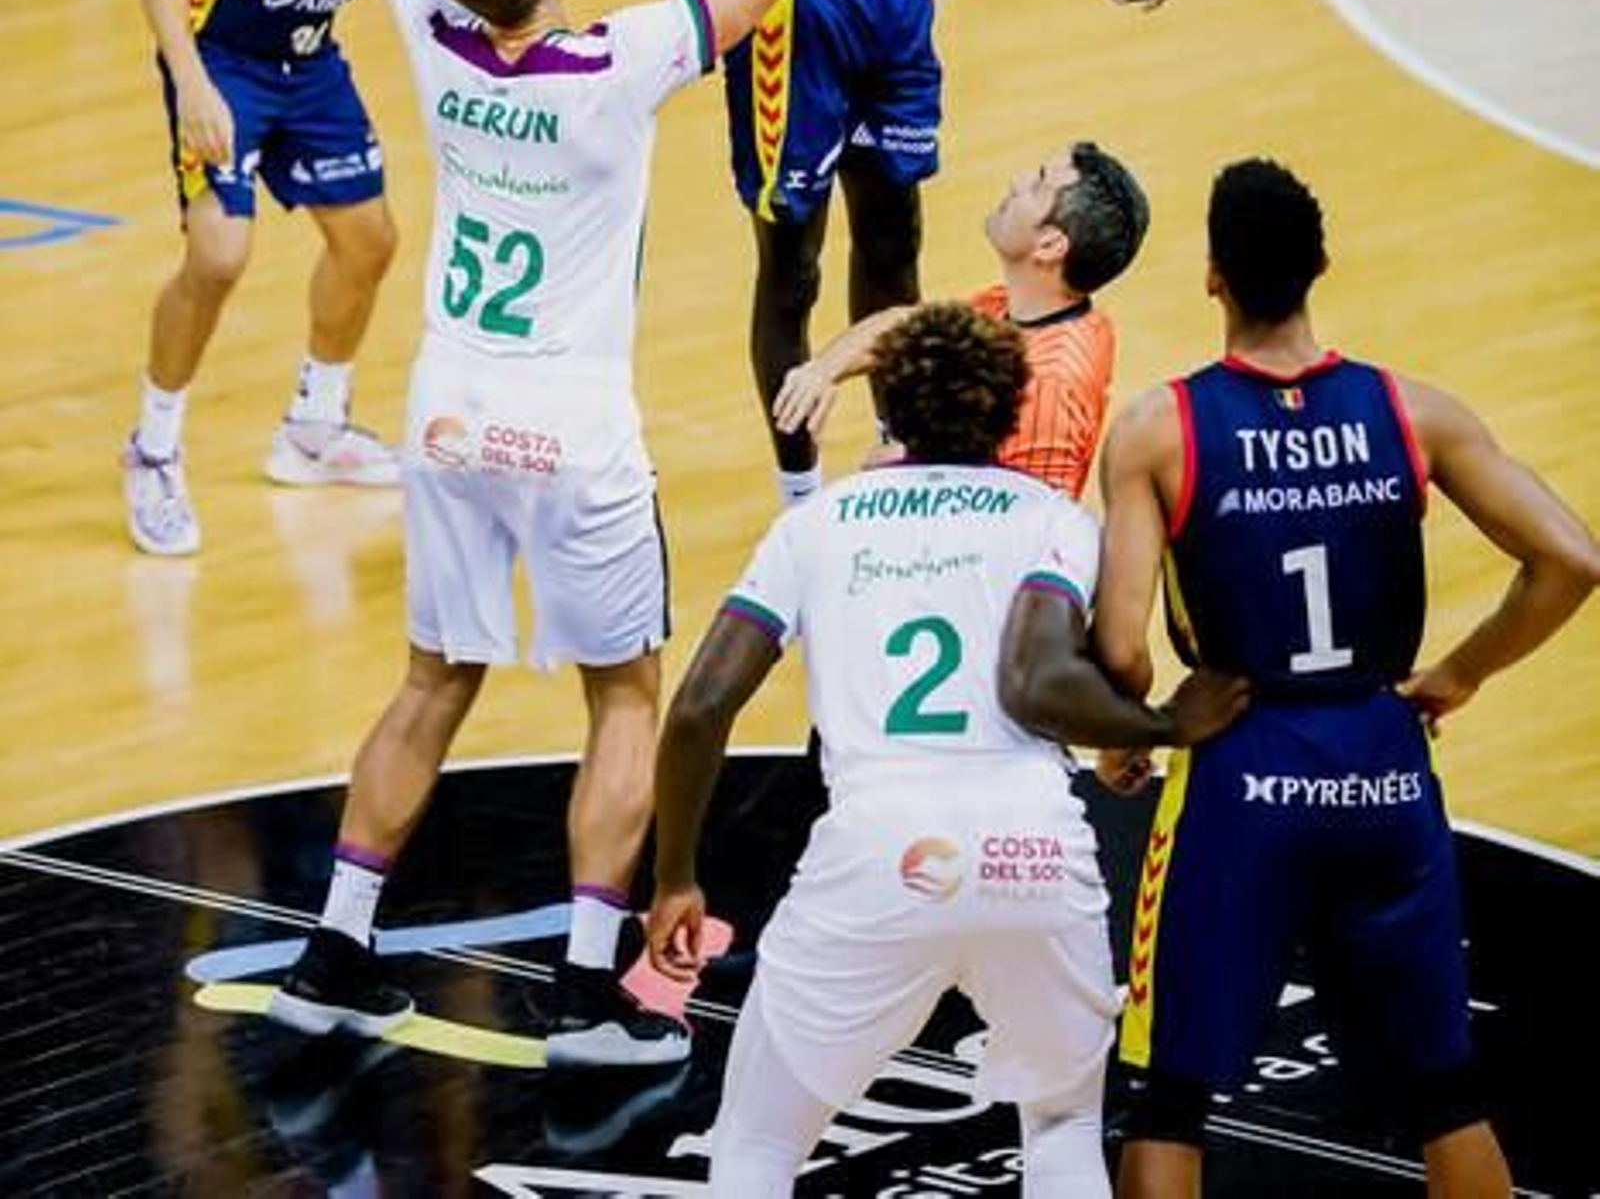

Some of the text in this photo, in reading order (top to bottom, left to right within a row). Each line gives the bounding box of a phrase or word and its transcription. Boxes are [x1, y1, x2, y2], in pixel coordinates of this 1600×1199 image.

[437, 89, 560, 144] GERUN
[443, 212, 545, 338] 52
[481, 446, 517, 469] DEL
[484, 424, 561, 457] COSTA
[1235, 422, 1371, 472] TYSON
[838, 484, 1020, 523] THOMPSON
[1244, 477, 1401, 514] MORABANC
[1282, 544, 1354, 673] 1
[884, 615, 969, 736] 2
[982, 837, 1064, 860] COSTA
[980, 862, 1024, 881] DEL
